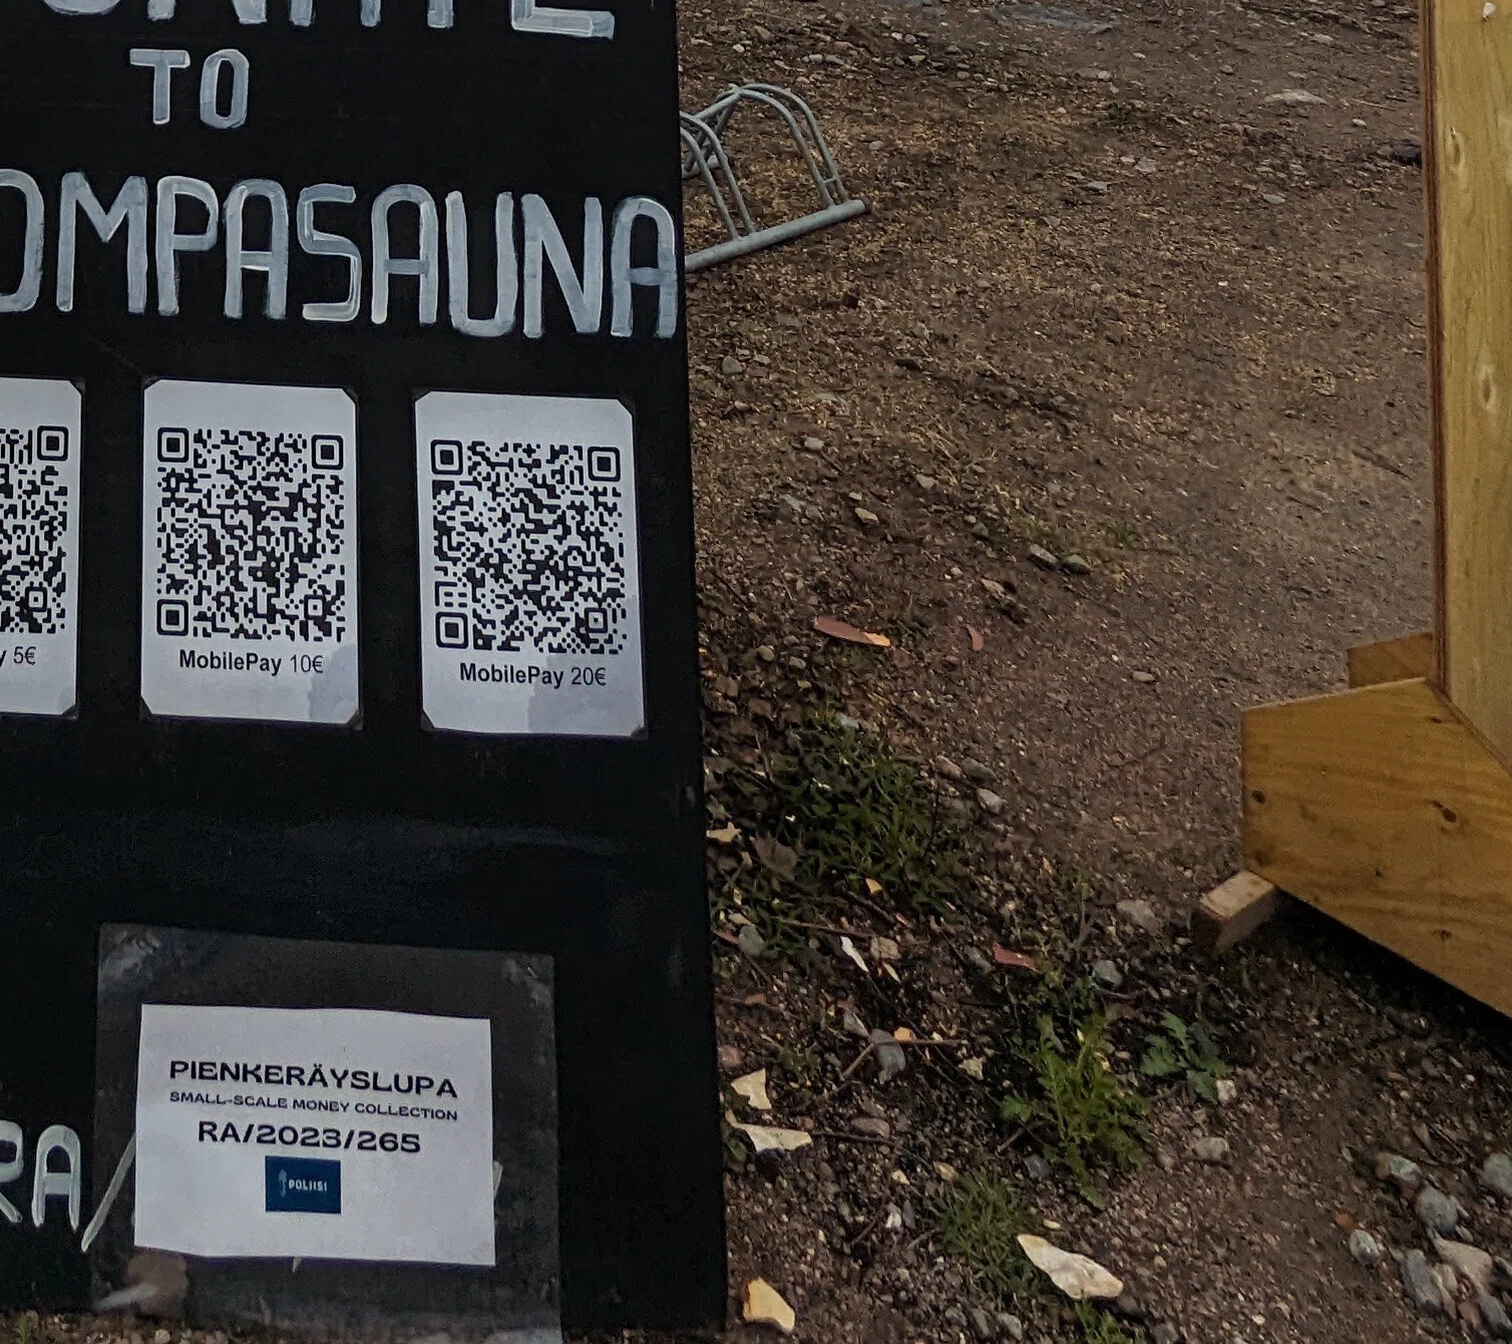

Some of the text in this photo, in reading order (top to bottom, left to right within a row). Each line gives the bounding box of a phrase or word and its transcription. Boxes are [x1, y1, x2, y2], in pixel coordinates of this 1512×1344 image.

[129, 48, 250, 129] TO
[13, 646, 37, 665] 5€
[179, 649, 324, 676] MobilePay 10€
[460, 662, 607, 689] MobilePay 20€
[169, 1060, 458, 1099] PIENKERÄYSLUPA
[169, 1091, 458, 1121] SMALL-SCALE MONEY COLLECTION
[197, 1120, 421, 1153] RA/2023/265
[288, 1178, 328, 1192] POLIISI
